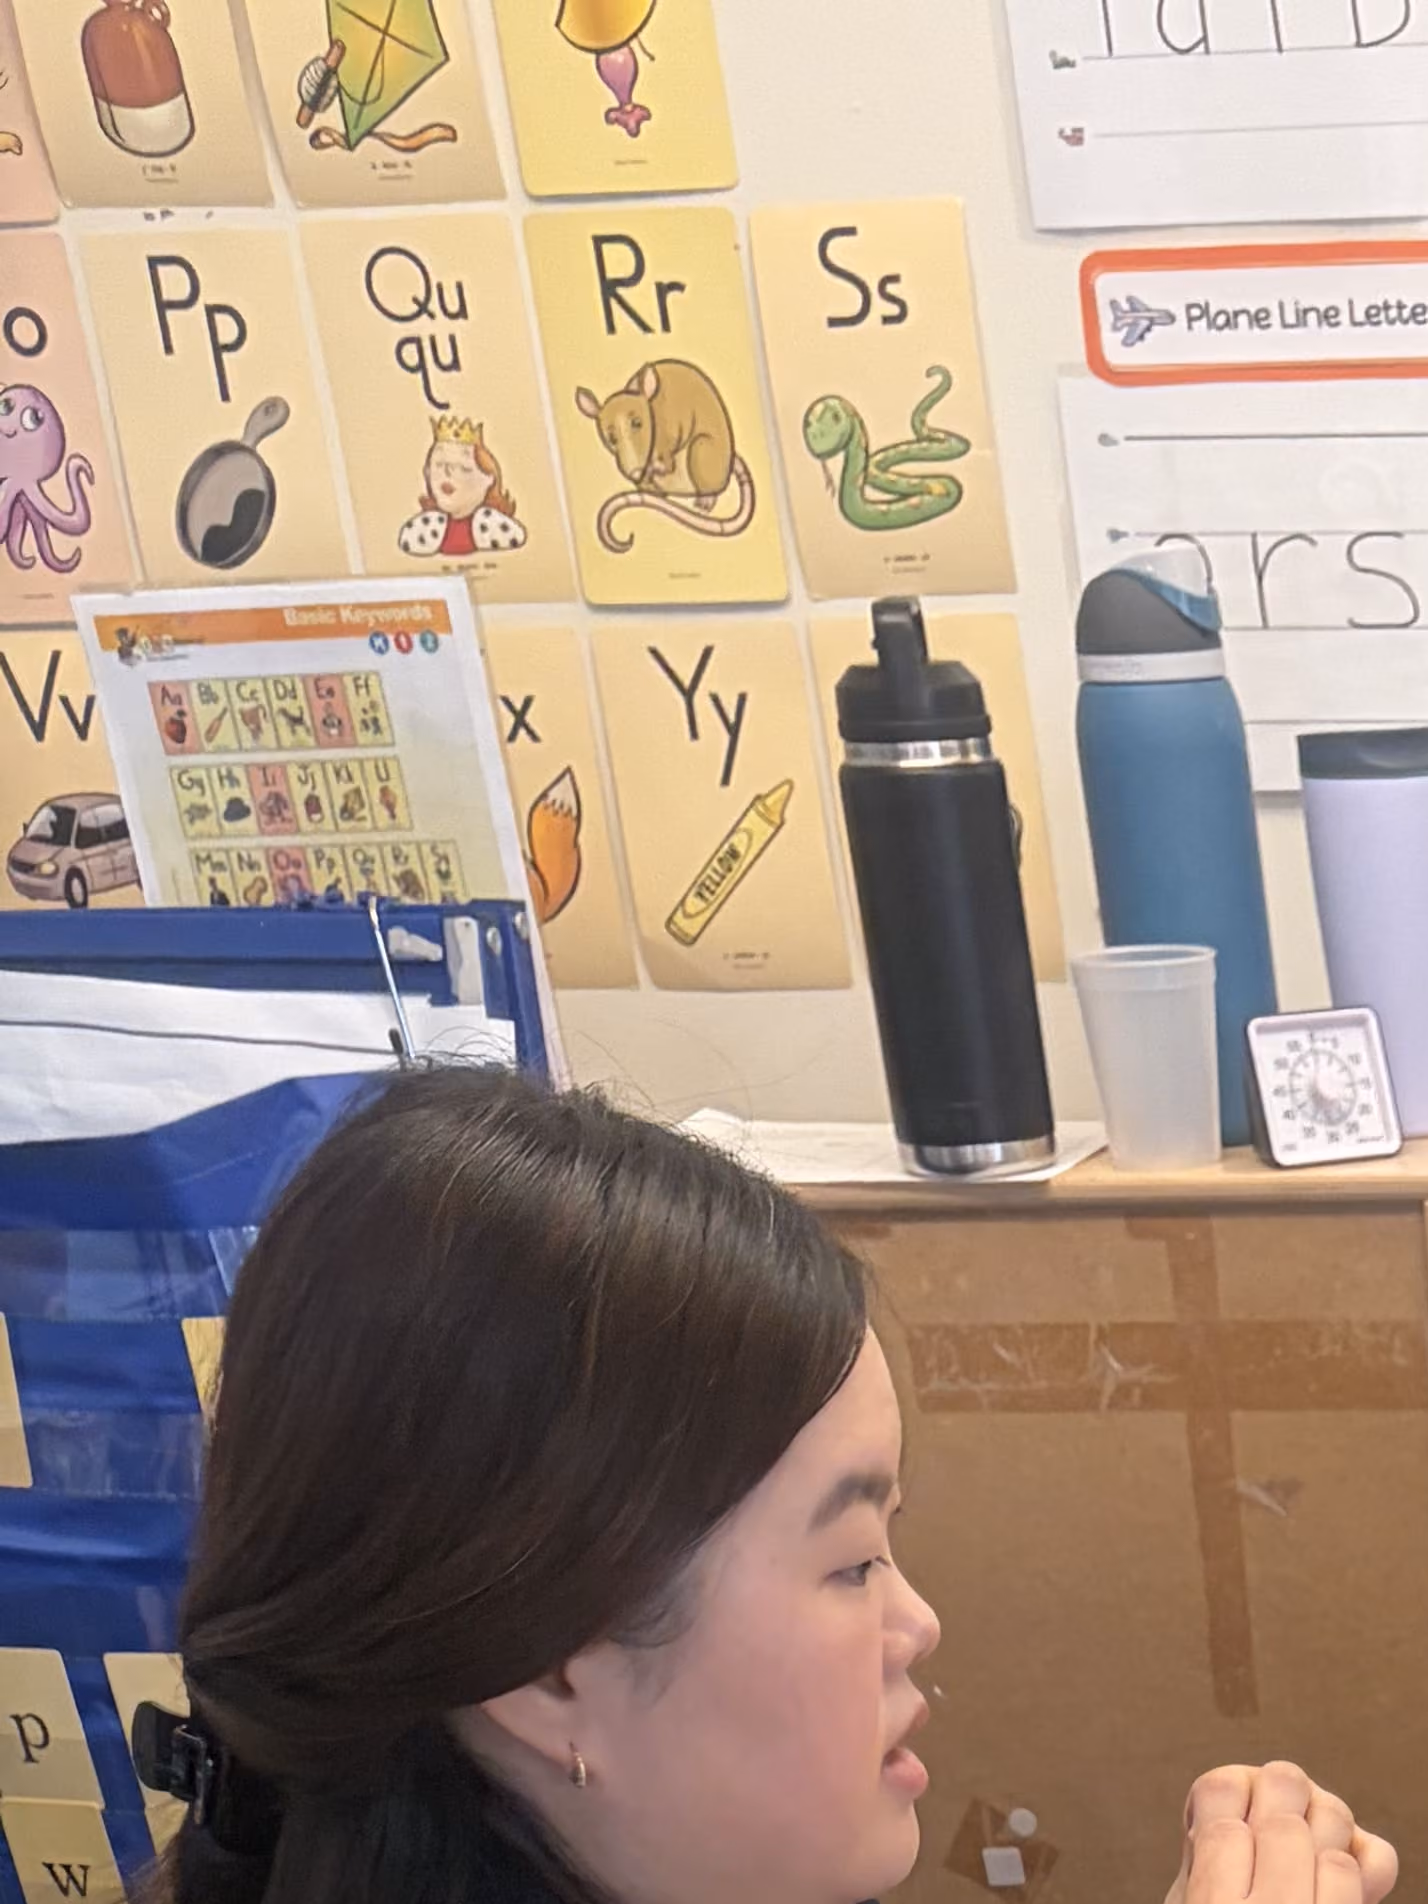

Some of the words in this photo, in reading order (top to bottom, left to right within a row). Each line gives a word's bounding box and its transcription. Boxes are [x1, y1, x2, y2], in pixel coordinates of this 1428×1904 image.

[364, 246, 468, 324] Qu
[590, 234, 686, 335] Rr
[817, 226, 909, 329] Ss
[1185, 302, 1271, 332] Plane
[1278, 300, 1341, 329] Line
[146, 255, 247, 402] Pp
[394, 332, 463, 409] qu
[283, 608, 336, 626] Basic
[339, 603, 432, 627] Keywords
[0, 650, 96, 743] Vv
[647, 645, 747, 787] Yy
[695, 843, 740, 904] YELLOW
[10, 1712, 49, 1764] p
[42, 1861, 89, 1898] w
